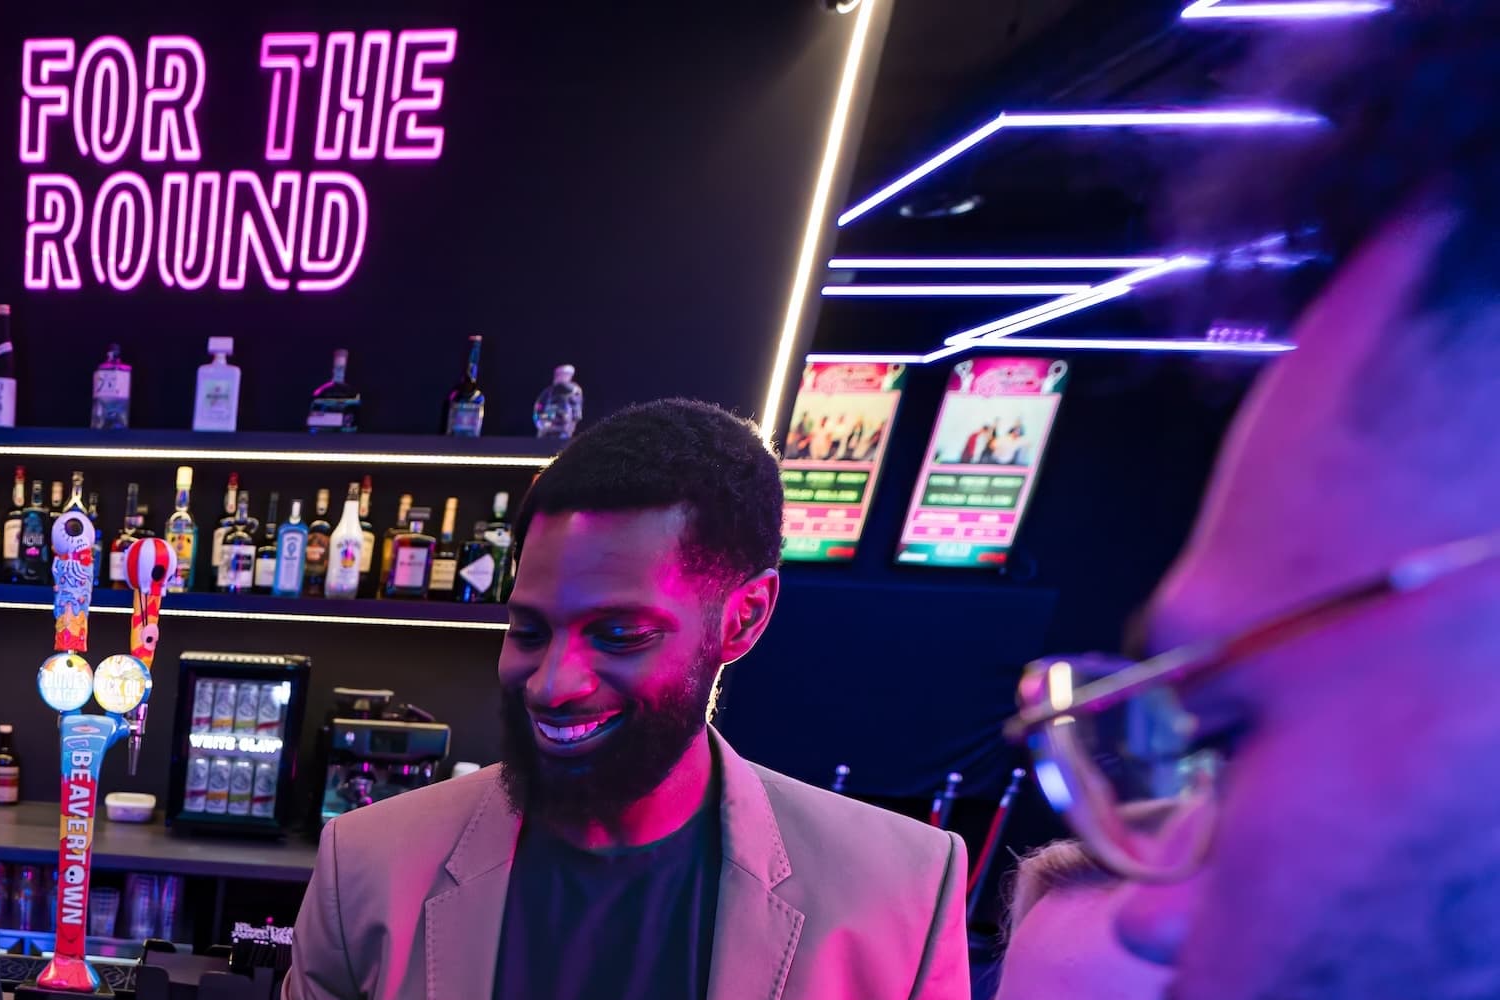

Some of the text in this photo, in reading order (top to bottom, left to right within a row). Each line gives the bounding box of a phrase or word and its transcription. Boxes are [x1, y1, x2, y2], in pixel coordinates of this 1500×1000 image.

[18, 34, 207, 164] FOR
[260, 28, 458, 162] THE
[23, 170, 369, 291] ROUND
[62, 751, 93, 925] BEAVERTOWN
